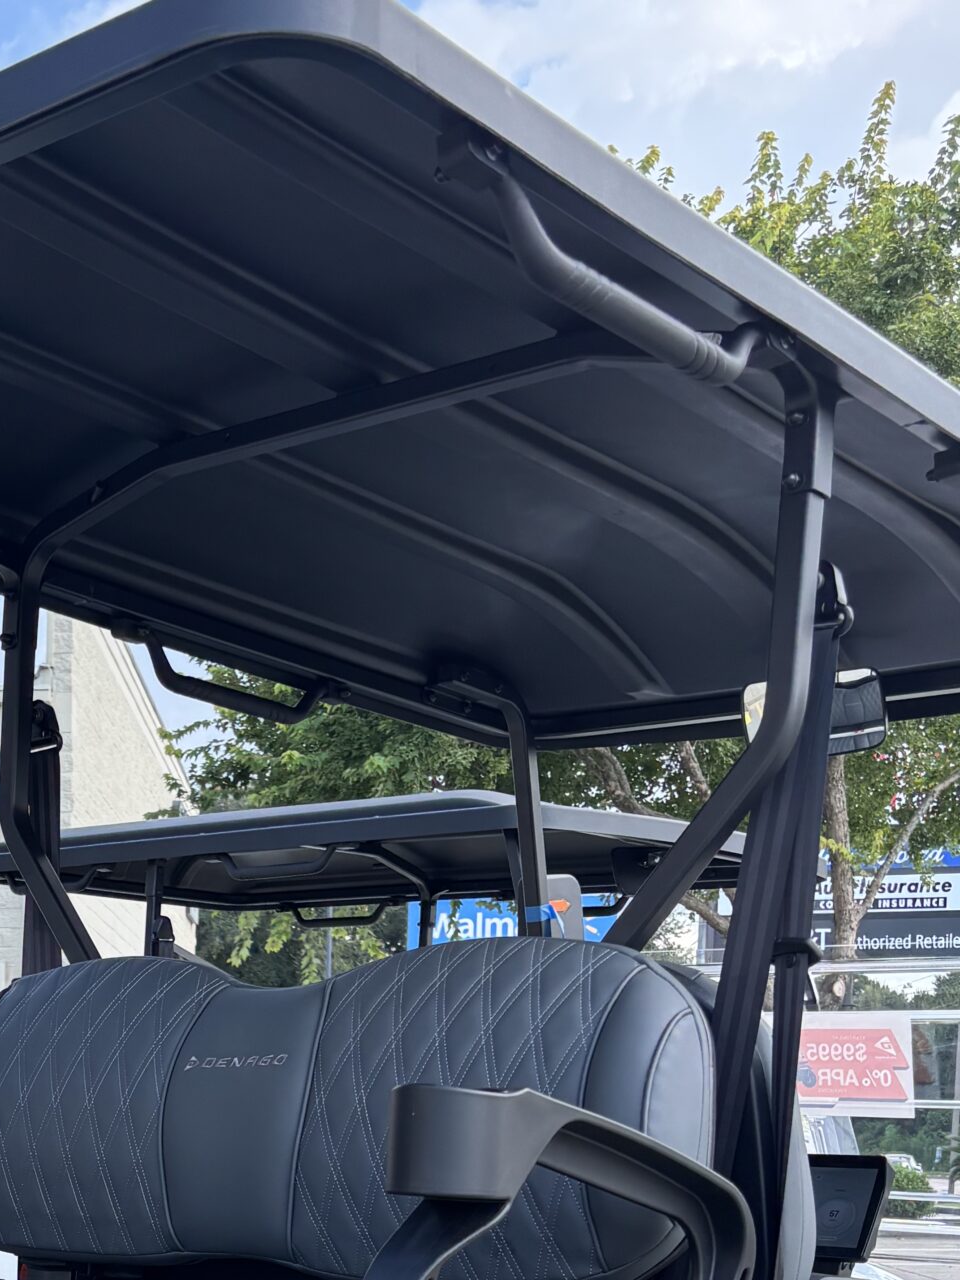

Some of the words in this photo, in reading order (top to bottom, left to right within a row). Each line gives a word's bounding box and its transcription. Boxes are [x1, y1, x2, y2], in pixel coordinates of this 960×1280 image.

[878, 897, 945, 909] INSURANCE
[432, 911, 519, 939] Walm
[855, 933, 911, 950] thorized
[915, 932, 960, 949] Retaile
[201, 1053, 288, 1069] DENAGO
